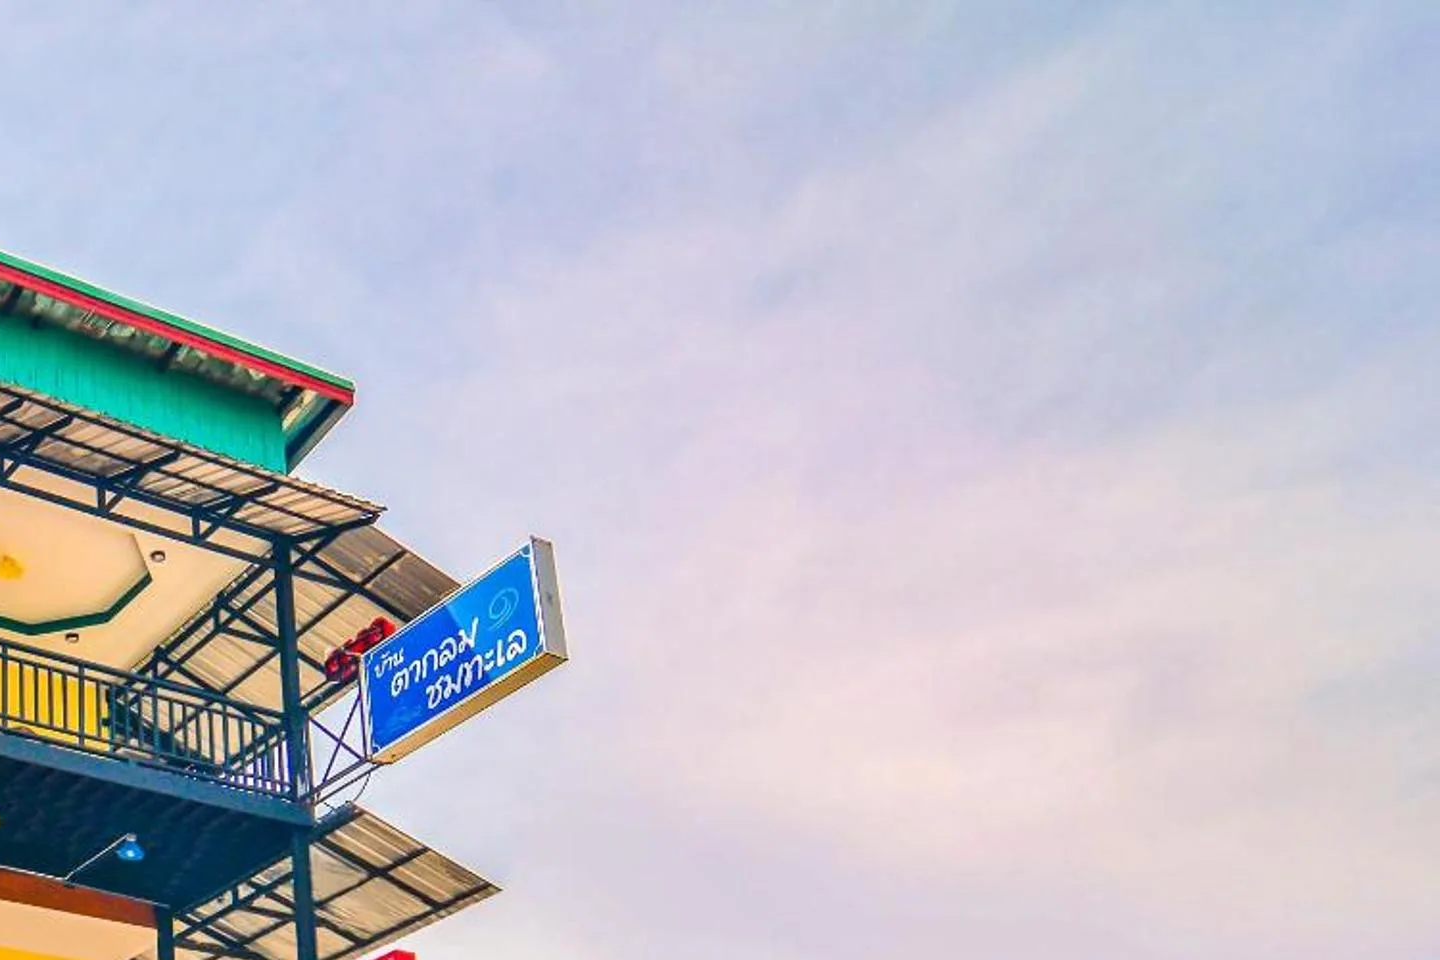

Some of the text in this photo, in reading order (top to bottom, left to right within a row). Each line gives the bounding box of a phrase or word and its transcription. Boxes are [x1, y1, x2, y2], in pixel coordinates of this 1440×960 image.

[374, 647, 405, 679] บ้าน
[390, 617, 479, 698] ตากลม
[426, 628, 527, 709] ชมทะเล
